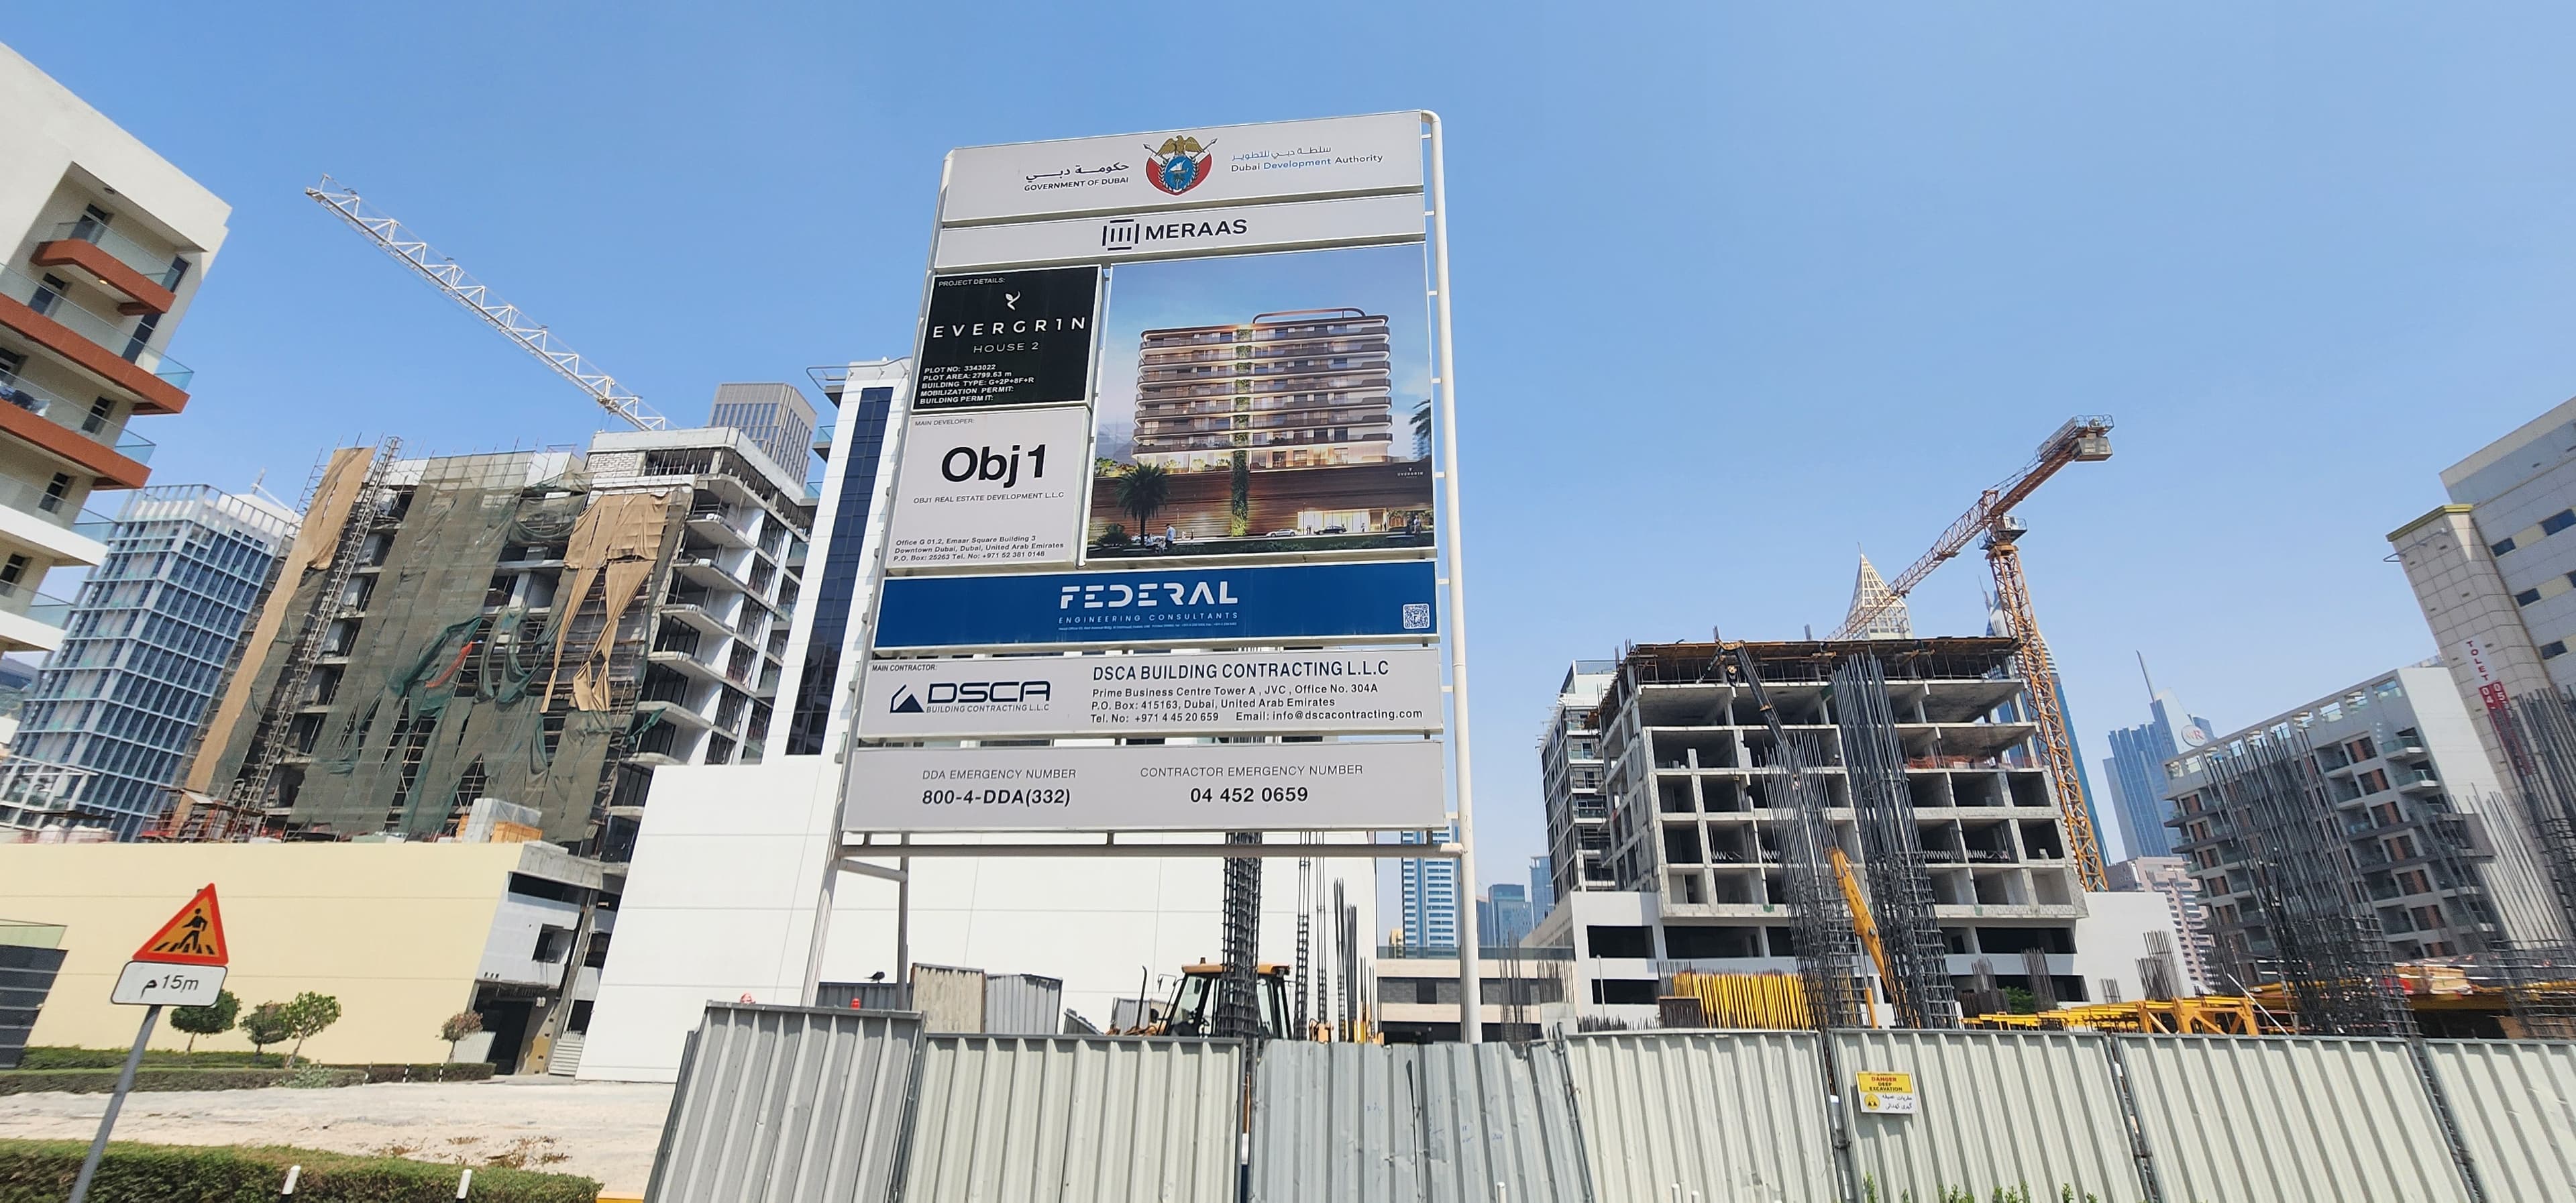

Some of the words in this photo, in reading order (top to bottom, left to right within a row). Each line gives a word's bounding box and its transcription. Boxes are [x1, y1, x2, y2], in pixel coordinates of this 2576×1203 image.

[1075, 162, 1129, 174] حكومة
[1231, 163, 1260, 172] Dubai
[1264, 158, 1331, 169] Development
[1335, 154, 1383, 164] Authority
[1026, 168, 1071, 182] دبي
[1024, 180, 1085, 191] GOVERNMENT
[1146, 219, 1247, 240] MERAAS
[933, 317, 1085, 338] EVERGR1N
[973, 343, 1025, 353] HOUSE
[1031, 342, 1038, 350] 2
[964, 364, 996, 372] 3343022
[922, 381, 960, 389] BUILDING
[920, 388, 977, 397] MOBILIZATION
[920, 397, 959, 405] BUILDING
[941, 444, 1046, 488] Obj1
[987, 492, 1043, 501] DEVELOPMENT
[1059, 581, 1238, 609] FEDERAL
[1059, 615, 1140, 624] ENGINEERING
[1148, 612, 1238, 621] CONSULTANTS
[1093, 666, 1136, 680] DSCA
[1141, 664, 1217, 680] BUILDING
[1222, 661, 1342, 678] CONTRACTING
[1348, 660, 1389, 676] L.L.C
[927, 680, 1051, 704] DSCA
[1093, 688, 1122, 698] Prime
[1125, 688, 1173, 697] Business
[1177, 687, 1211, 696] Centre
[1214, 686, 1246, 695] Tower
[1248, 686, 1256, 695] A
[1265, 685, 1286, 694] JVC
[1295, 684, 1327, 694] Office
[1330, 684, 1348, 693] No.
[1351, 683, 1378, 692] 304A
[926, 705, 965, 713] BUILDING
[967, 704, 1027, 713] CONTRACTING
[1091, 701, 1111, 711] P.O.
[1115, 701, 1138, 710] Box:
[1141, 700, 1181, 710] 415163,
[1184, 699, 1218, 709] Dubai,
[1221, 698, 1255, 708] United
[1258, 698, 1284, 707] Arab
[1287, 697, 1335, 707] Emirates
[1090, 714, 1108, 723] Tel.
[1112, 714, 1128, 723] No:
[1162, 713, 1167, 722] 4
[1171, 713, 1183, 722] 45
[1185, 713, 1197, 722] 20
[1200, 713, 1218, 721] 659
[1236, 711, 1269, 721] Email:
[1273, 709, 1422, 721] info@dscacontracting.com
[922, 770, 946, 780] DDA
[950, 770, 1022, 779] EMERGENCY
[1026, 769, 1076, 779] NUMBER
[1140, 767, 1223, 777] CONTRACTOR
[1228, 766, 1305, 776] EMERGENCY
[1309, 764, 1362, 775] NUMBER
[922, 788, 1070, 807] 800-4-DDA(332)
[1191, 788, 1213, 802] 04
[1220, 788, 1254, 802] 452
[1262, 787, 1307, 802] 0659
[162, 975, 199, 993] 15m
